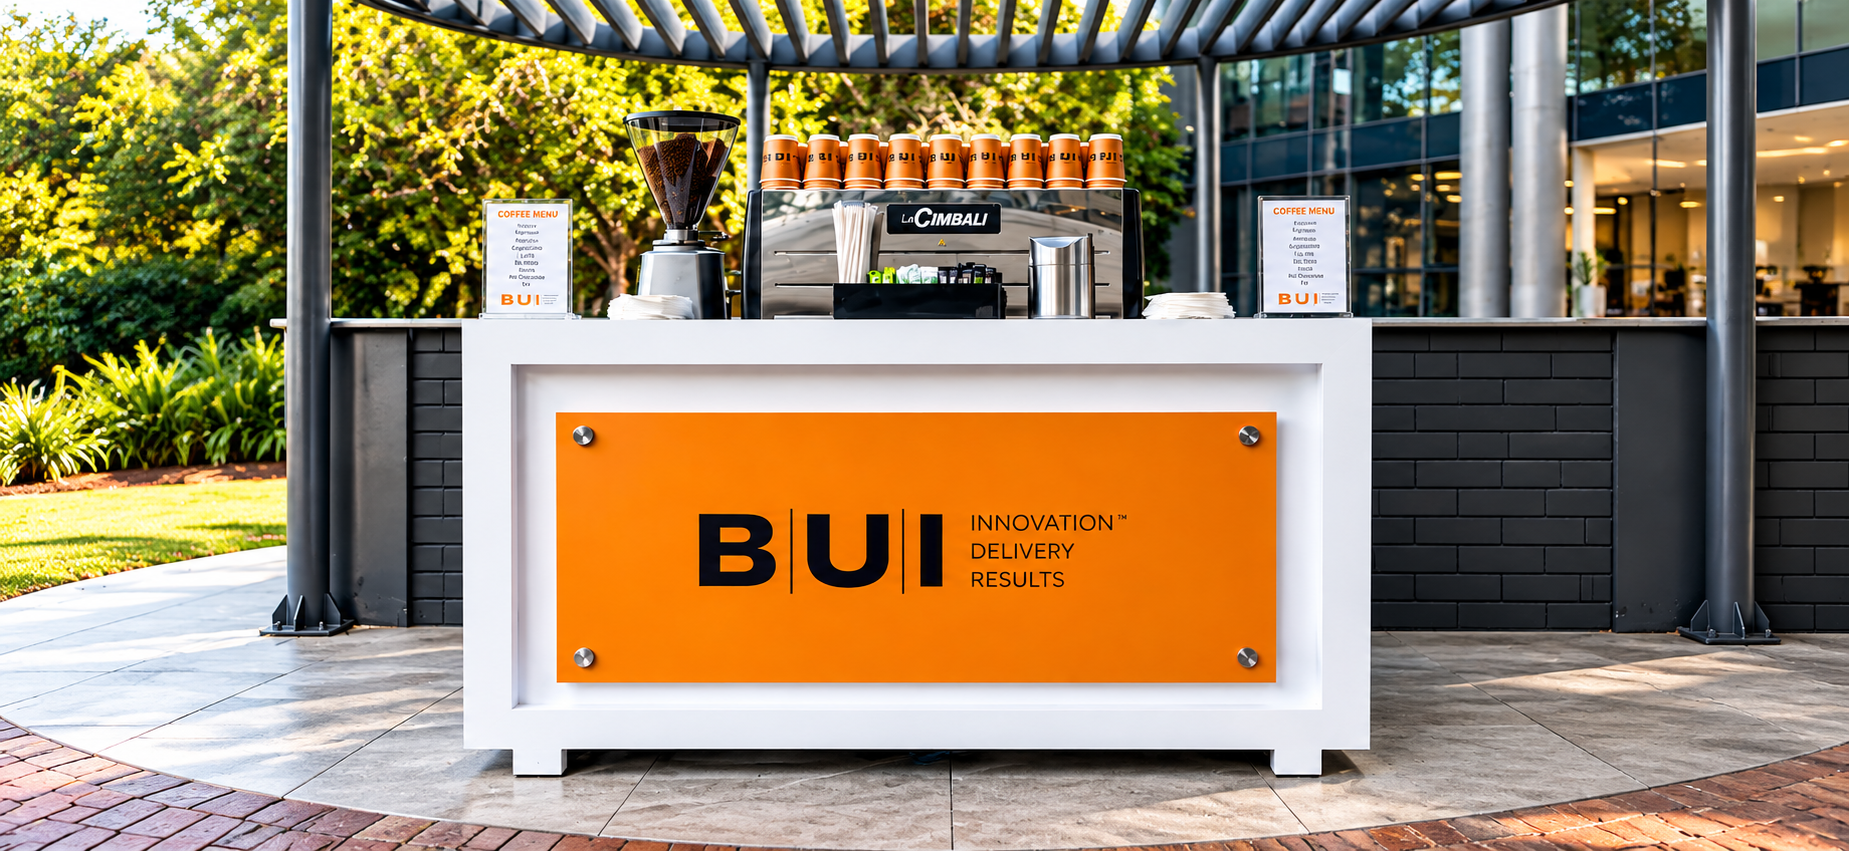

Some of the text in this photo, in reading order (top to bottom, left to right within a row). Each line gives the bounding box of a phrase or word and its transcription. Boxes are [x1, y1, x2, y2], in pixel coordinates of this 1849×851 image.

[498, 210, 559, 218] COFFEE MENU
[914, 207, 988, 228] CIMBALI
[1273, 207, 1335, 215] COFFEE MENU
[501, 294, 540, 306] BUI
[1278, 292, 1318, 305] BUI
[971, 543, 1075, 559] DELIVERY
[971, 571, 1065, 588] RESULTS
